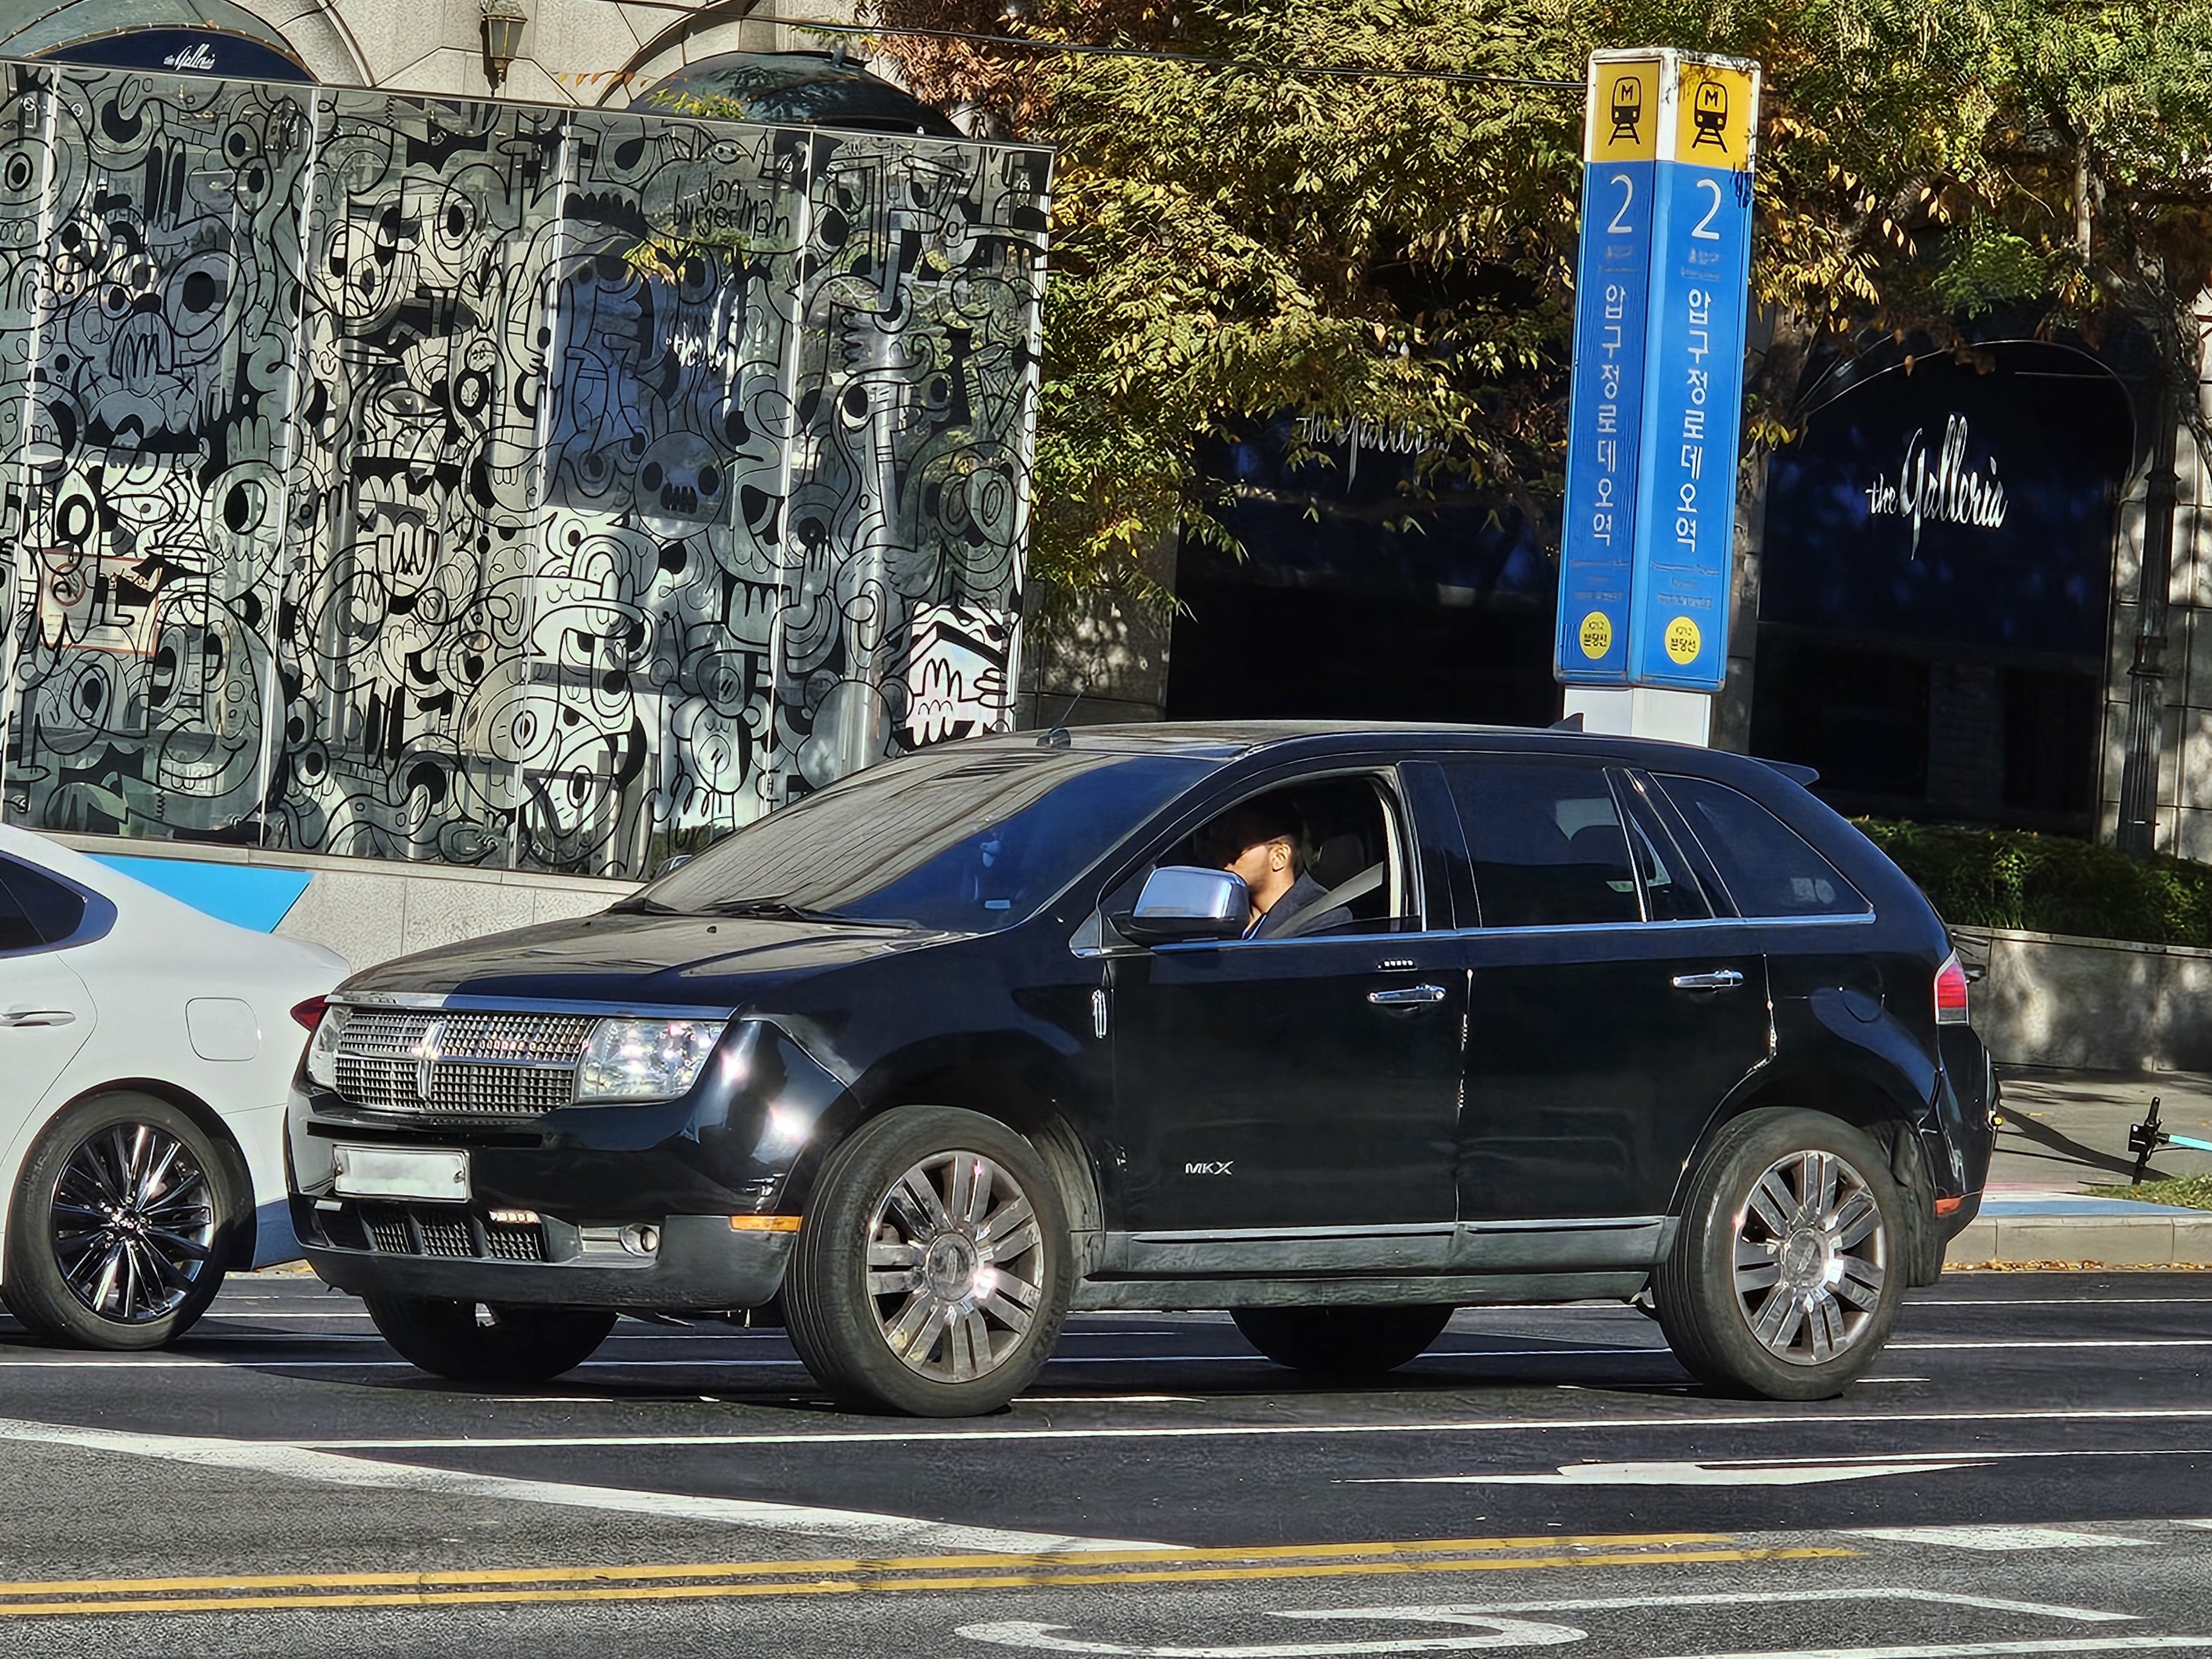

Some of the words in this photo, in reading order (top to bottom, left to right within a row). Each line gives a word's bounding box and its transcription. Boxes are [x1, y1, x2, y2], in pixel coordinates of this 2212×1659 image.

[1622, 84, 1633, 102] M
[1704, 90, 1718, 108] M
[1607, 173, 1633, 233] 2
[1691, 178, 1721, 240] 2
[1593, 284, 1627, 546] 압구정로데오역
[1675, 288, 1712, 552] 압구정로데오역
[1865, 473, 1898, 514] the
[1900, 413, 2008, 561] Galleria
[1584, 633, 1607, 647] 분당선
[1671, 638, 1696, 653] 분당선
[1185, 1160, 1234, 1176] MKX
